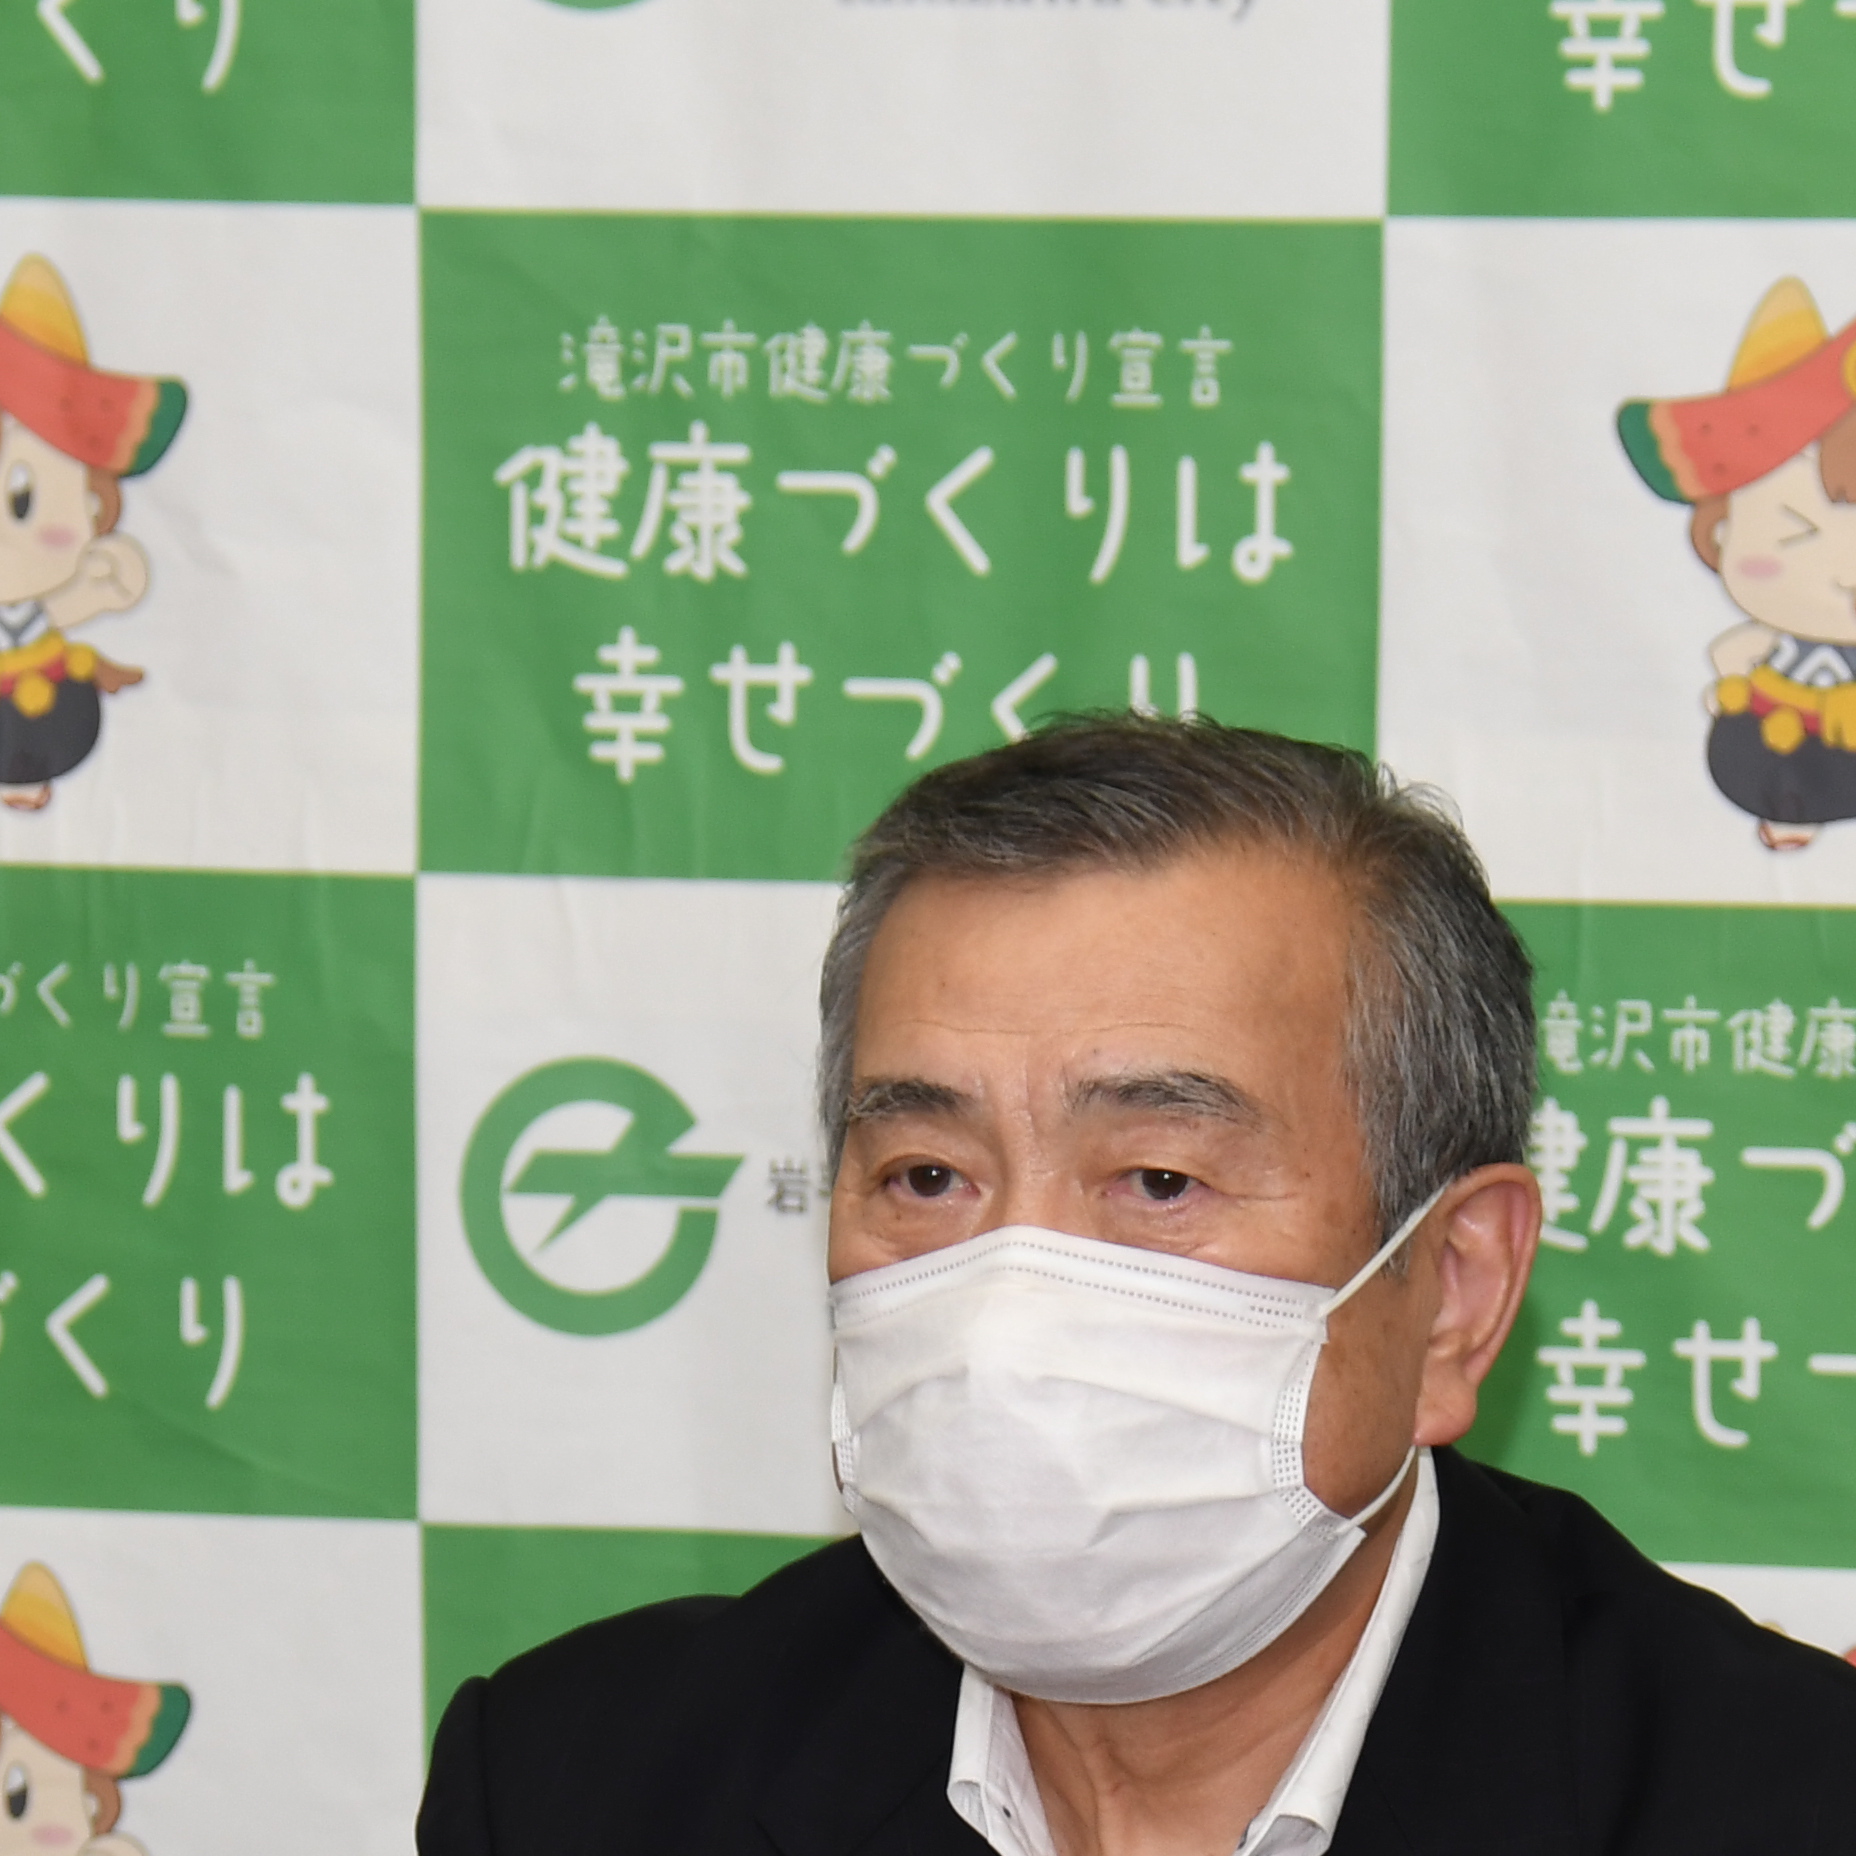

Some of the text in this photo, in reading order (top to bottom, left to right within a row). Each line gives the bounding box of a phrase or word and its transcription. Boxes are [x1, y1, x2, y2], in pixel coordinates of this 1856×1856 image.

[559, 315, 1233, 407] 滝沢市健康づくり宣言
[493, 420, 1295, 586] 健康づくりは
